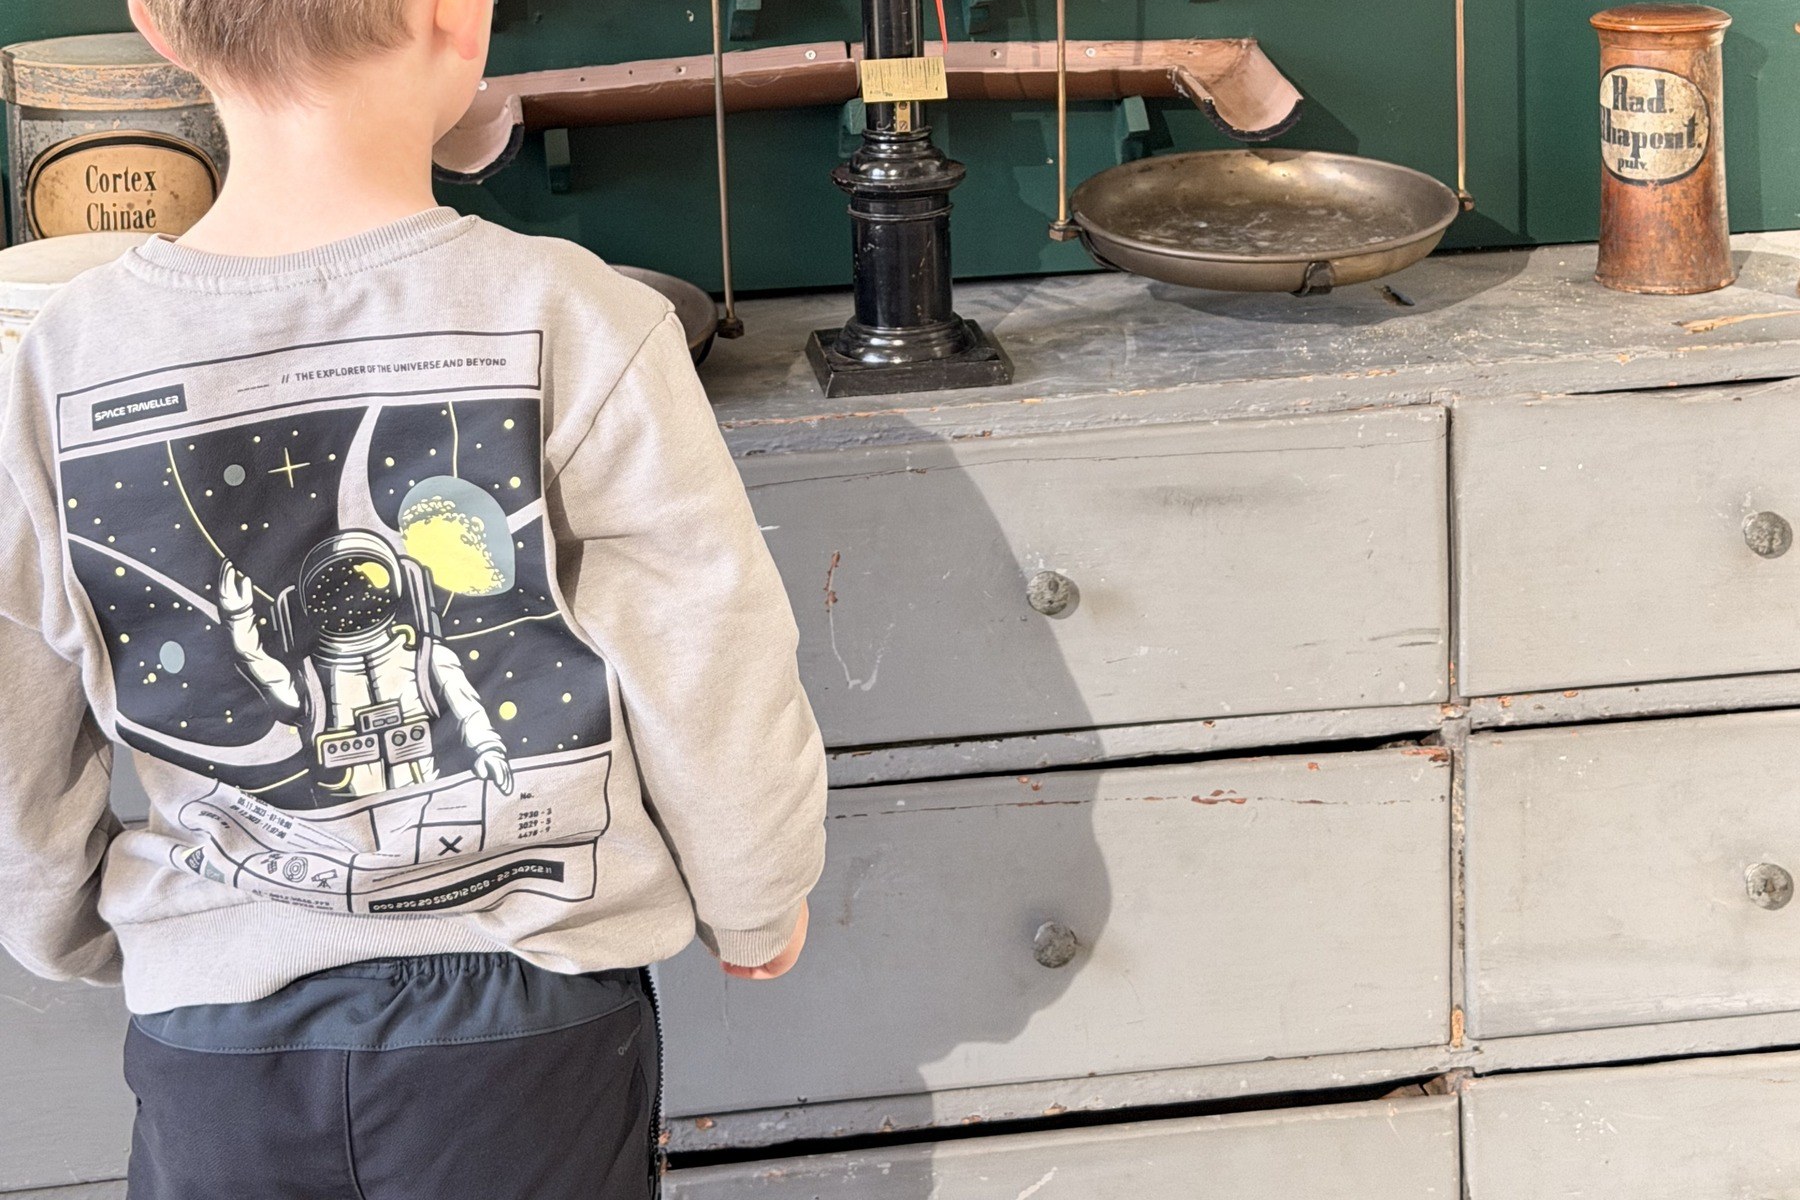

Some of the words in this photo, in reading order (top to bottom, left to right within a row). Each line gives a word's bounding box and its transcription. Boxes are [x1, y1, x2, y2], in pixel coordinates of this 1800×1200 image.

[1611, 74, 1674, 114] Rad.
[86, 164, 157, 194] Cortex
[1617, 158, 1648, 173] pulv.
[87, 202, 157, 232] Chinae
[295, 371, 315, 382] THE
[316, 365, 366, 379] EXPLORER
[367, 364, 377, 374] OF
[377, 364, 392, 373] THE
[393, 360, 441, 373] UNIVERSE
[442, 358, 464, 368] AND
[466, 357, 507, 367] BEYOND
[94, 406, 126, 422] SPACE
[127, 395, 180, 414] TRAVELLER
[520, 792, 535, 800] No.
